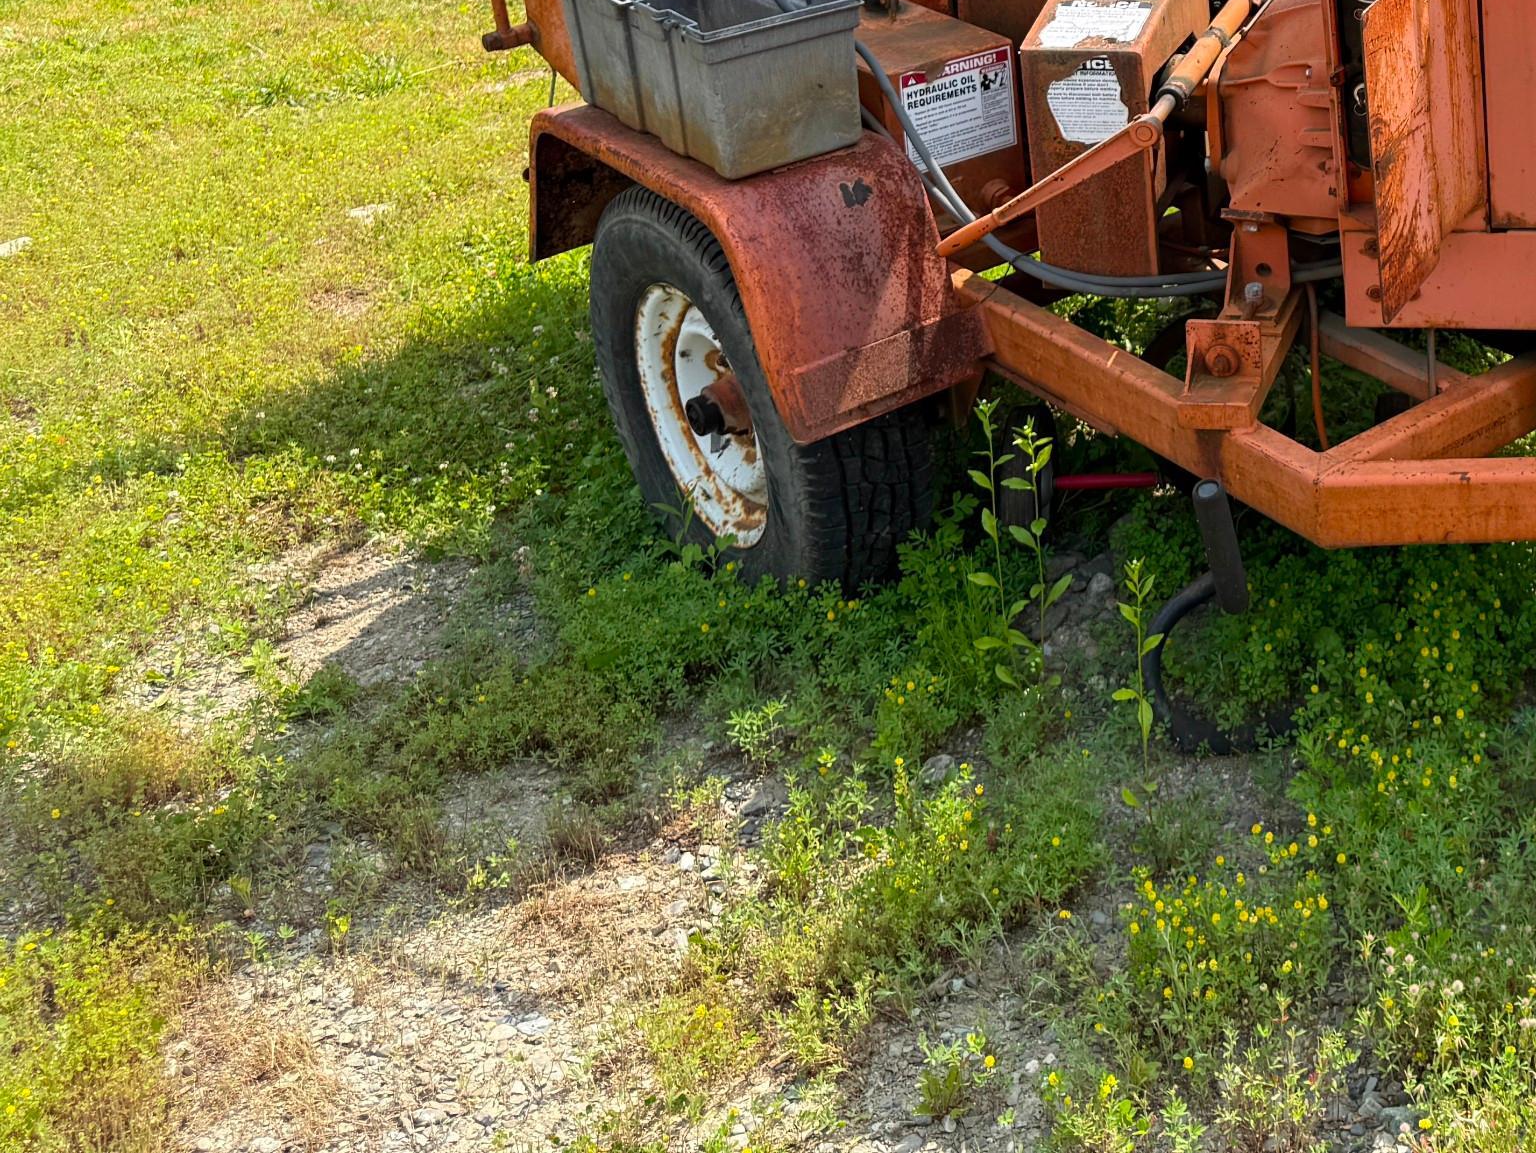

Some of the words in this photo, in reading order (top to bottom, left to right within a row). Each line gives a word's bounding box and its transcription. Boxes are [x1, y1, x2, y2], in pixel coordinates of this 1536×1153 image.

[940, 53, 997, 77] ARNING!
[906, 79, 958, 101] HYDRAULIC
[960, 74, 976, 86] OIL
[907, 84, 978, 110] REQUIREMENTS
